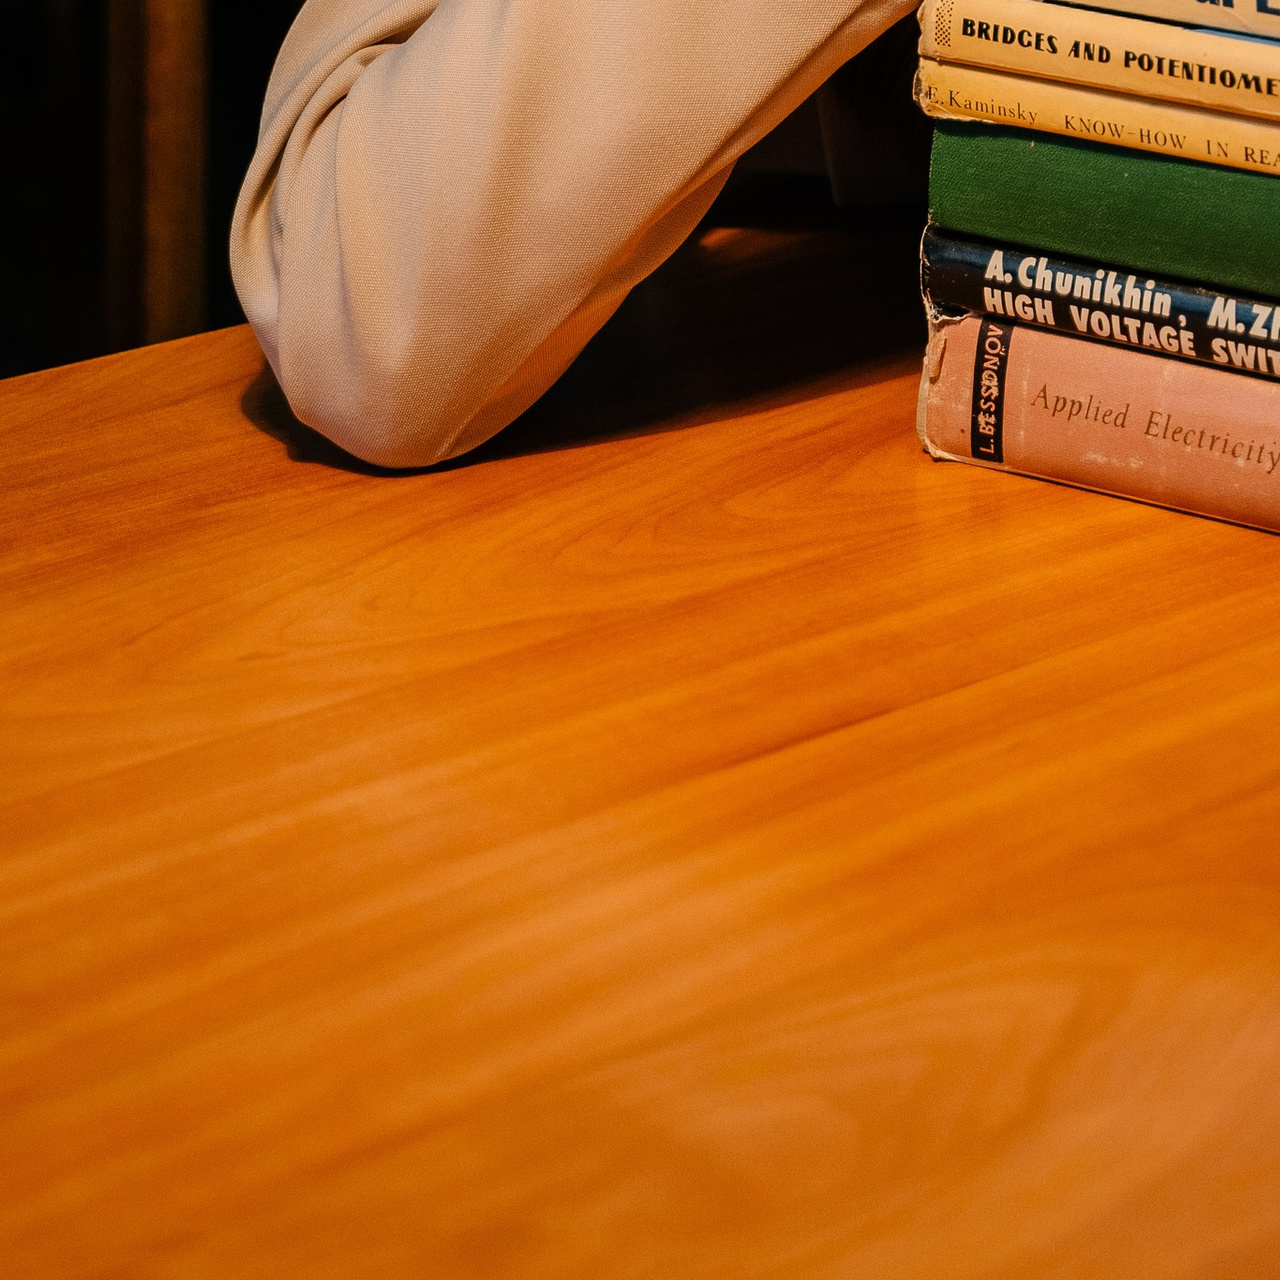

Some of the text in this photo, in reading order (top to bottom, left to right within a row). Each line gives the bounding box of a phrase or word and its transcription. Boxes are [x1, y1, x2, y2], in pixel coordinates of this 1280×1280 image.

[962, 17, 1058, 56] BRIDGES
[1068, 40, 1112, 65] AND
[1064, 114, 1187, 151] KNOW-HOW
[1206, 140, 1231, 159] IN
[984, 287, 1054, 326] HIGH
[1070, 305, 1196, 357] VOLTAGE
[1030, 382, 1130, 430] Applied
